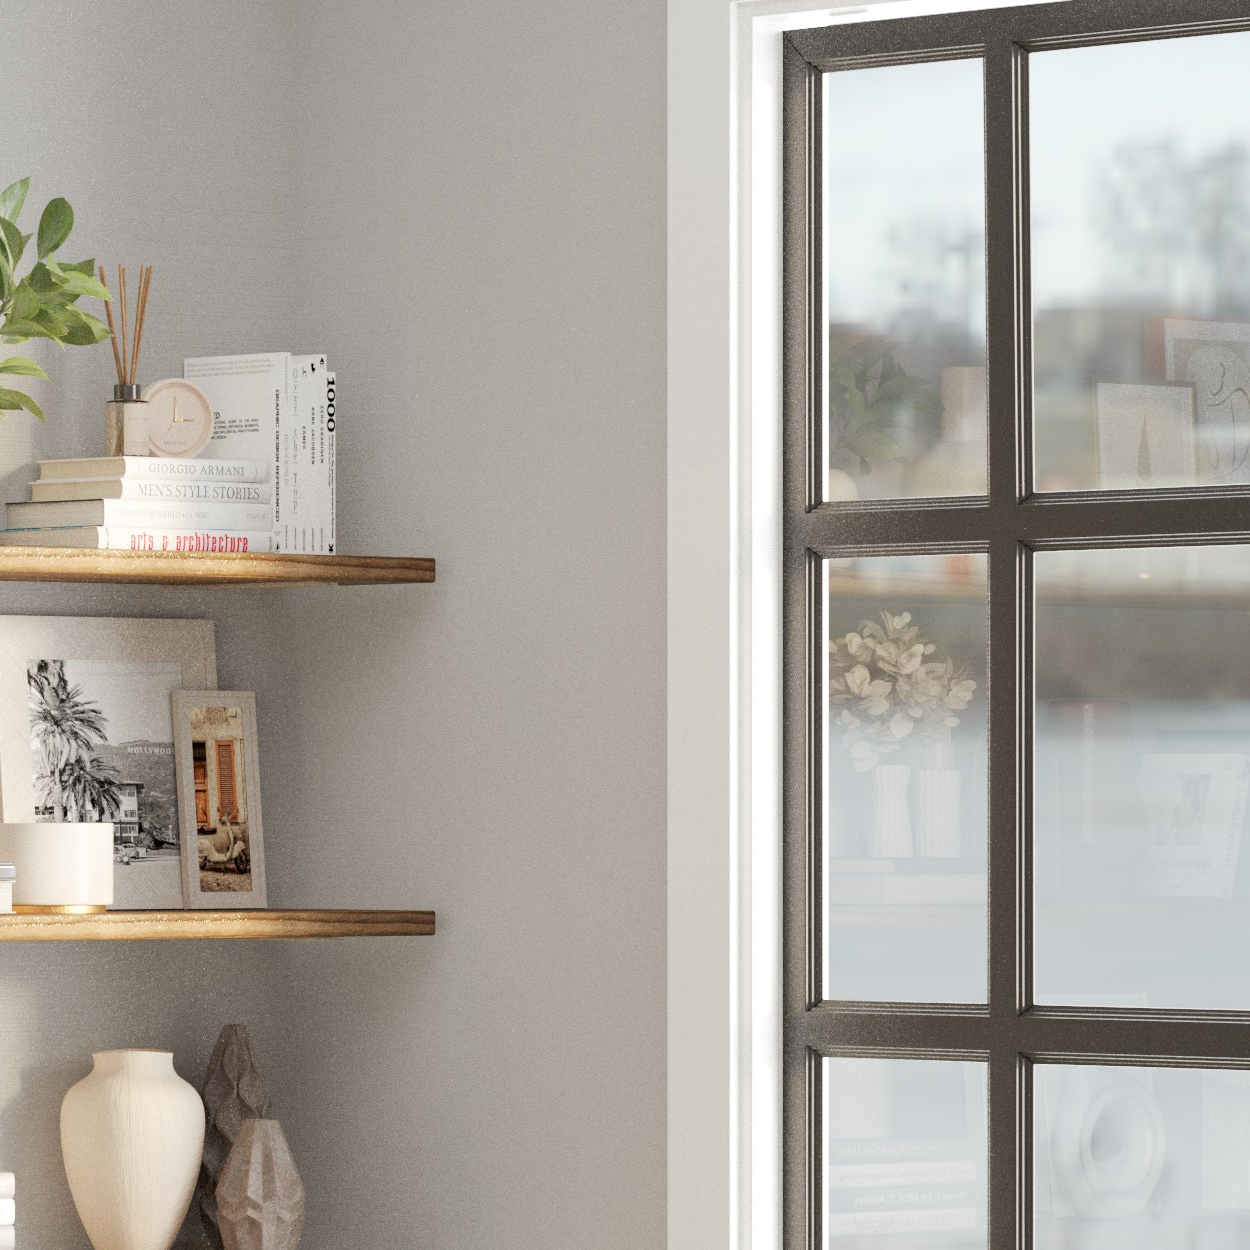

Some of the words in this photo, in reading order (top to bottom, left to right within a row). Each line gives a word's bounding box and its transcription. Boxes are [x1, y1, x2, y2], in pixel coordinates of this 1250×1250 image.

[326, 376, 336, 433] 1000
[148, 463, 196, 476] GIORGIO
[199, 465, 245, 478] ARMANI
[138, 483, 173, 498] MEN'S
[174, 485, 210, 499] STYLE
[212, 486, 261, 501] STORIES
[130, 532, 154, 551] arts
[175, 532, 249, 554] architecture
[127, 746, 175, 756] HOLLYWOO
